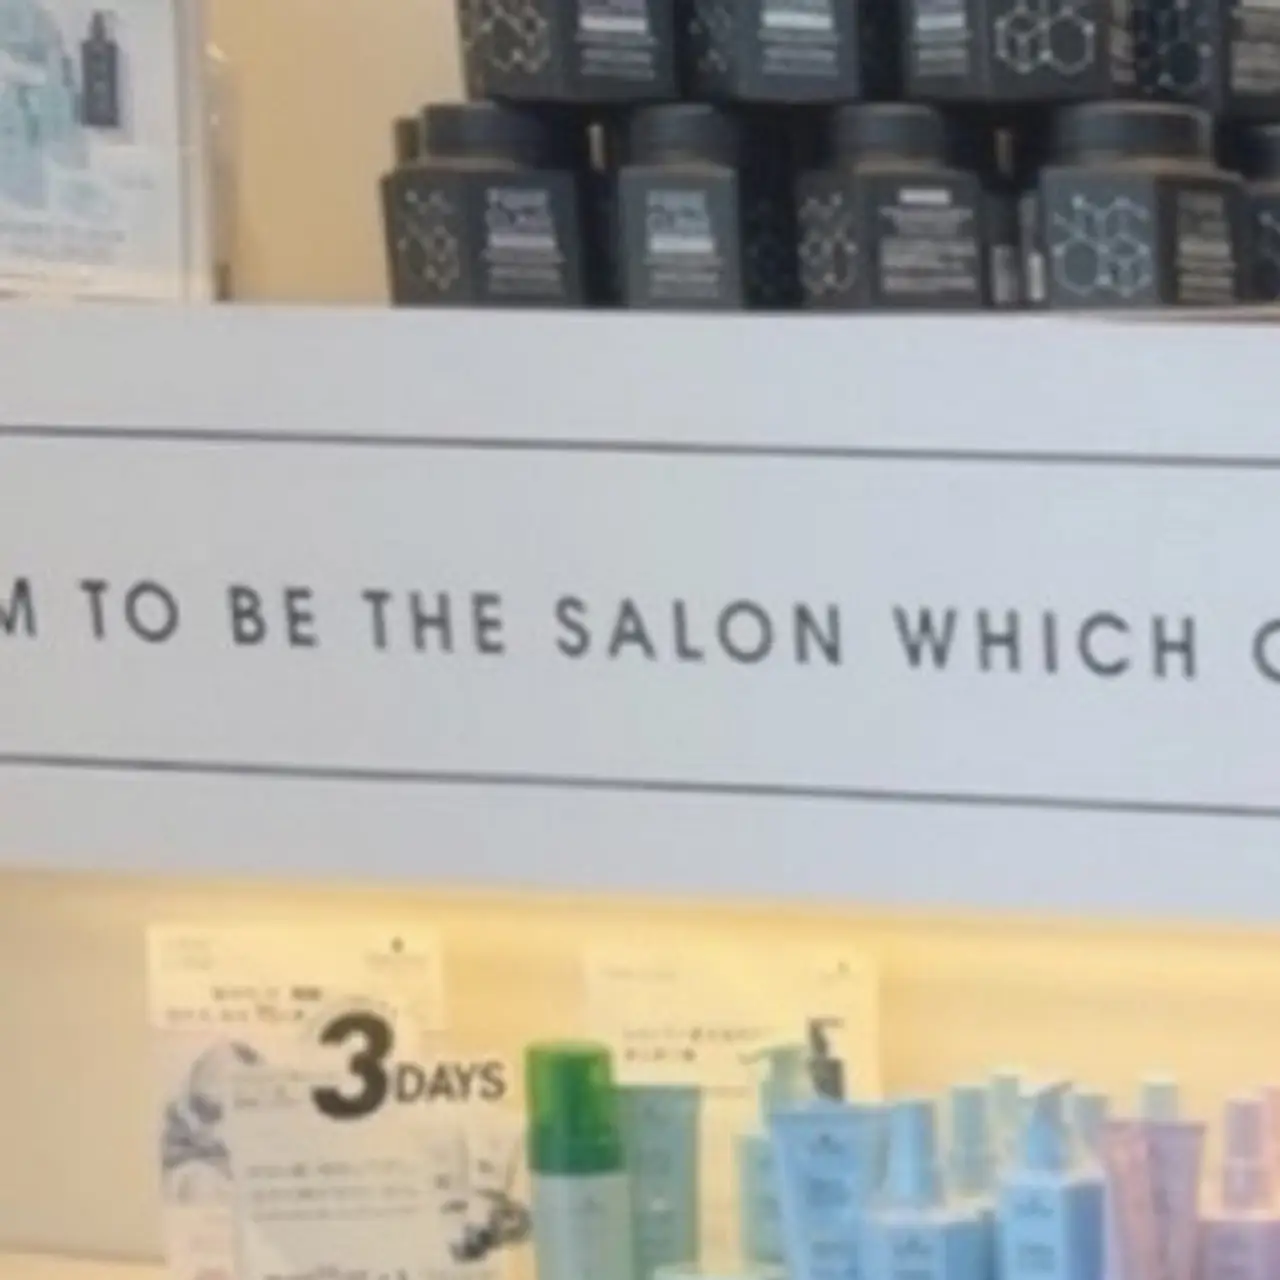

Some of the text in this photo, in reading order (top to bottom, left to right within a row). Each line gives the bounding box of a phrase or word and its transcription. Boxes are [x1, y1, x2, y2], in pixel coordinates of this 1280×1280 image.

[79, 578, 180, 643] TO
[226, 584, 318, 648] BE
[361, 588, 505, 654] THE
[554, 595, 843, 665] SALON
[892, 605, 1197, 679] WHICH
[311, 1009, 508, 1122] 3 DAYS
